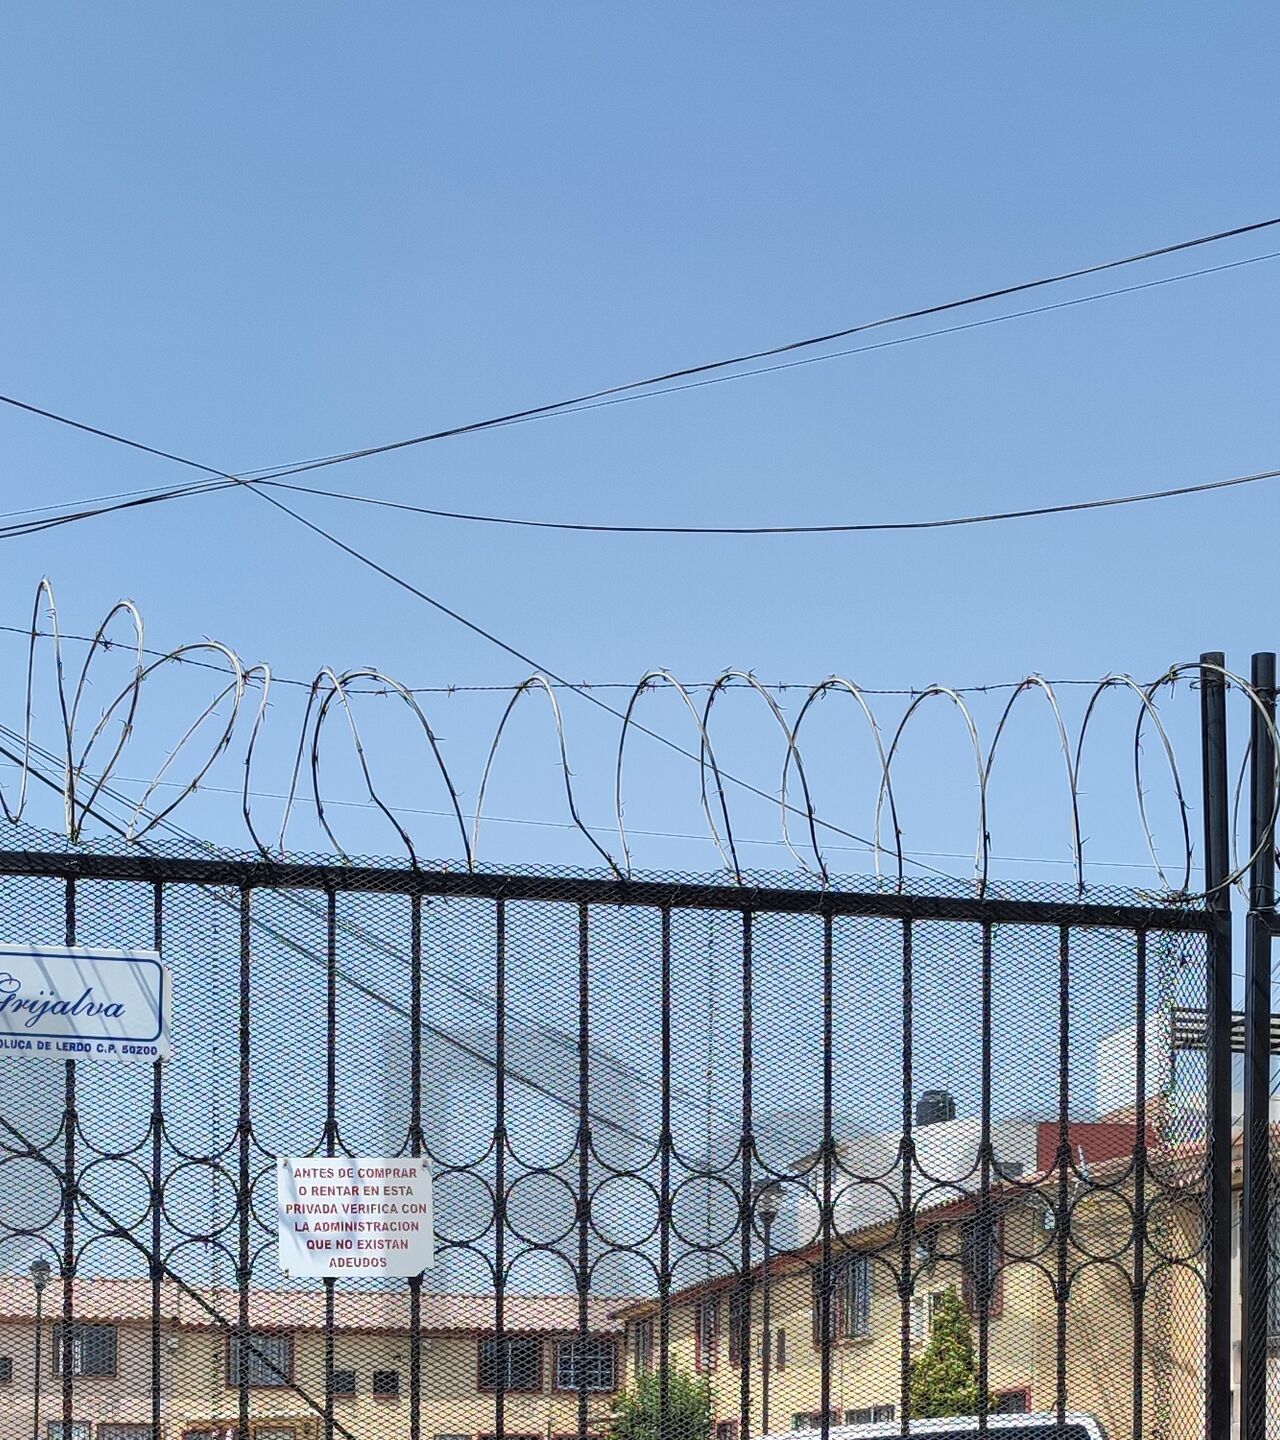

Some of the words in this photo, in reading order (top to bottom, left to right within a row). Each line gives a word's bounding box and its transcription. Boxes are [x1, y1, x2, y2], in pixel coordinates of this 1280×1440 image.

[37, 1041, 51, 1050] DE
[56, 1042, 91, 1053] LERDO
[96, 1044, 117, 1054] C.P.
[122, 1045, 157, 1056] 50200
[294, 1168, 334, 1178] ANTES
[338, 1168, 354, 1178] DE
[358, 1168, 417, 1178] COMPRAR
[299, 1186, 307, 1196] O
[311, 1186, 359, 1196] RENTAR
[363, 1186, 379, 1196] EN
[383, 1186, 413, 1196] ESTA
[286, 1204, 338, 1214] PRIVADA
[342, 1204, 398, 1214] VERIFICA
[401, 1204, 427, 1214] CON
[294, 1222, 310, 1232] LA
[313, 1222, 419, 1232] ADMINISTRACION
[306, 1240, 332, 1250] QUE
[335, 1240, 353, 1250] NO
[357, 1240, 409, 1250] EXISTAN
[329, 1257, 387, 1268] ADEUDOS
